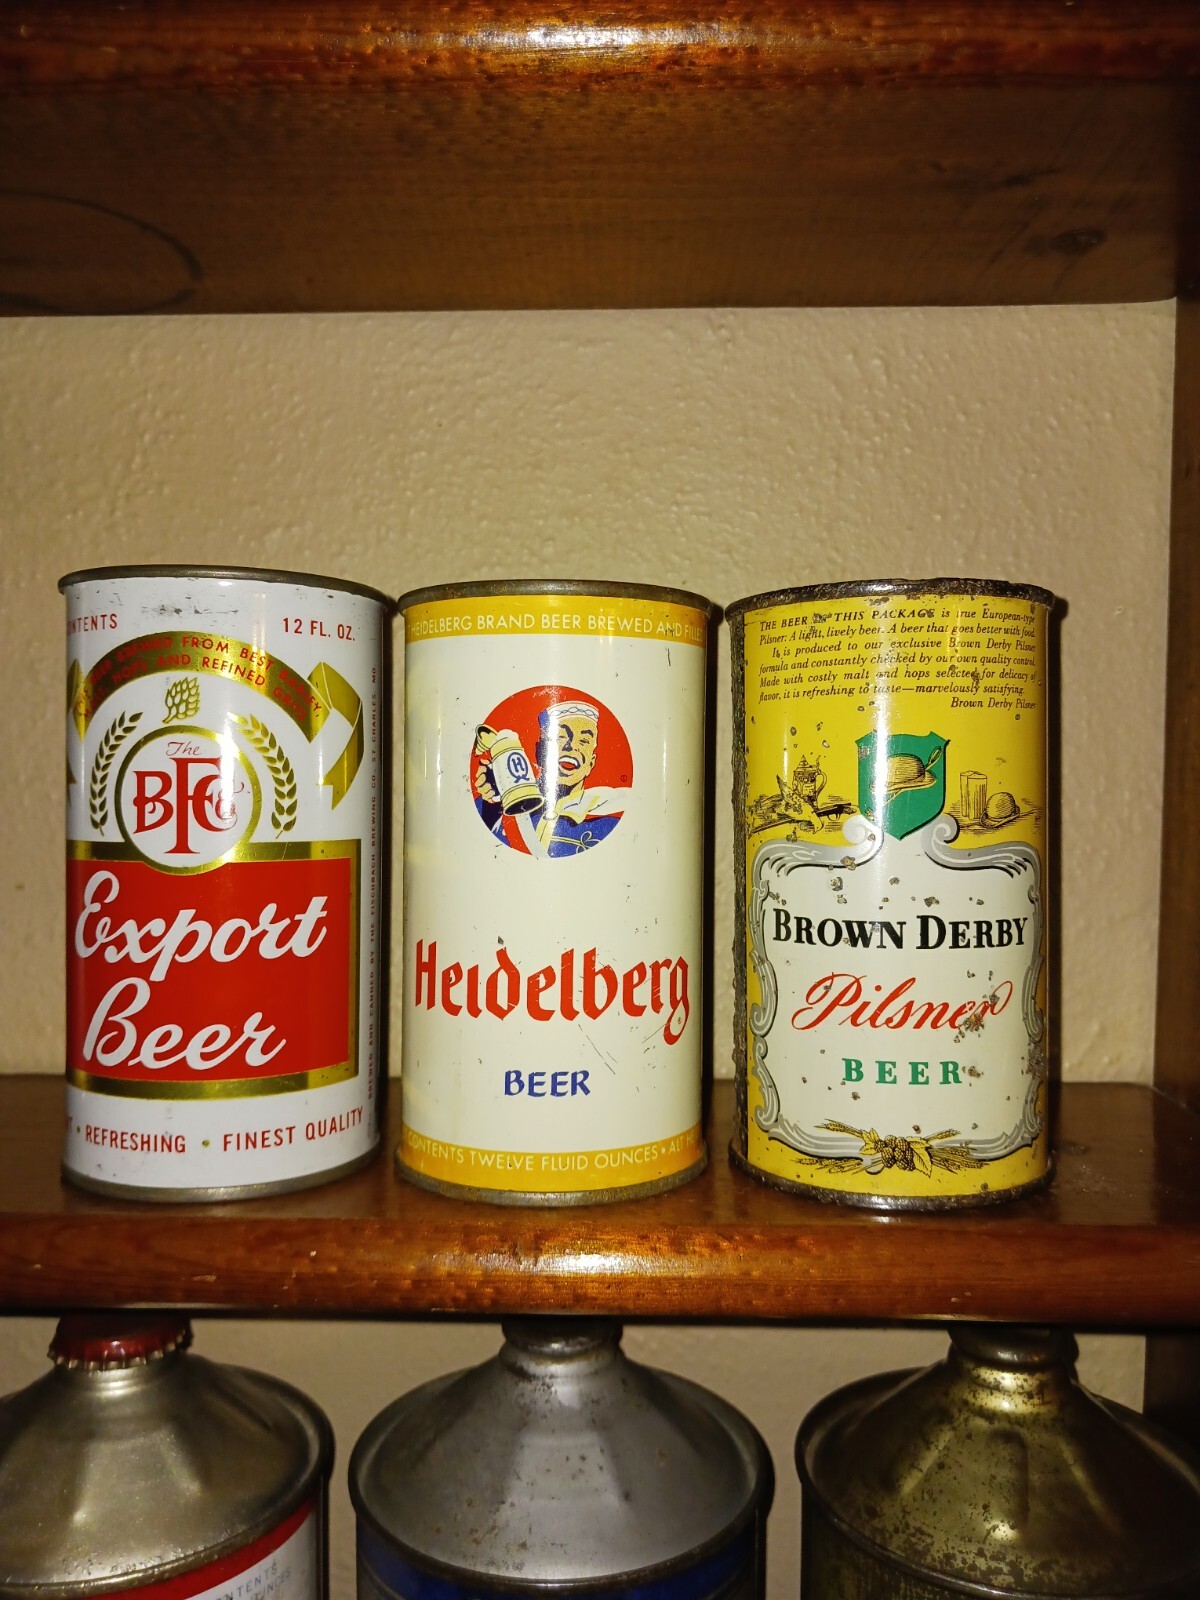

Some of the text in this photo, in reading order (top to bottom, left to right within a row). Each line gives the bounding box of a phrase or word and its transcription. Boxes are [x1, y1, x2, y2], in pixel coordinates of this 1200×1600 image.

[283, 617, 355, 641] 12 FL. OZ.
[411, 615, 473, 636] HEIDELBERG
[477, 613, 536, 630] BRAND
[541, 613, 581, 629] BEER
[587, 615, 653, 634] BREWED
[656, 621, 682, 638] AND
[760, 620, 777, 632] THE
[781, 616, 808, 628] BEER
[834, 610, 865, 621] THIS
[871, 608, 936, 620] PACKAGE
[941, 607, 951, 618] is
[982, 608, 1036, 626] European-type
[789, 631, 797, 642] A
[827, 625, 858, 639] lively
[859, 626, 885, 636] beer.
[887, 623, 897, 634] A
[900, 622, 924, 634] beer
[926, 622, 949, 633] that
[951, 625, 974, 636] goes
[976, 623, 1003, 635] better
[1003, 625, 1020, 637] with
[116, 636, 173, 663] BREWED
[182, 636, 229, 653] FROM
[240, 647, 275, 671] BEST
[783, 646, 791, 657] is
[795, 641, 842, 658] produced
[847, 642, 858, 651] to
[864, 641, 883, 650] our
[890, 638, 942, 649] exclusive
[949, 637, 981, 649] Brown
[986, 638, 1012, 652] Derby
[1015, 639, 1036, 652] Pilsner
[156, 654, 191, 667] AND
[202, 656, 266, 686] REFINED
[758, 660, 789, 677] formula
[791, 657, 809, 670] and
[811, 654, 868, 668] constantly
[919, 653, 933, 666] by
[936, 654, 956, 664] our
[956, 655, 978, 664] own
[980, 654, 1012, 667] quality
[760, 677, 780, 688] Made
[784, 673, 803, 685] with
[808, 671, 838, 684] costly
[844, 671, 870, 681] malt
[876, 667, 899, 679] and
[904, 668, 930, 681] hops
[979, 669, 996, 681] for
[999, 668, 1029, 682] delicacy
[783, 690, 791, 700] it
[793, 689, 801, 699] is
[802, 685, 856, 700] refreshing
[859, 686, 870, 695] to
[983, 683, 1026, 697] satisfying.
[950, 696, 1037, 711] Brown Derby Pilsner
[165, 741, 203, 757] The
[74, 869, 329, 982] Export
[771, 907, 1029, 950] BROWN DERBY
[414, 938, 691, 1046] Heidelberg
[791, 971, 1014, 1030] Pilsner
[82, 976, 287, 1071] Beer
[504, 1069, 591, 1098] BEER
[842, 1057, 962, 1086] BEER
[85, 1124, 187, 1153] REFRESHING
[222, 1125, 296, 1152] FINEST
[304, 1105, 364, 1141] QUALITY
[407, 1130, 465, 1164] CONTENTS
[469, 1150, 534, 1172] TWELVE
[541, 1154, 589, 1171] FLUID
[594, 1144, 659, 1170] OUNCES
[668, 1134, 684, 1154] ALT
